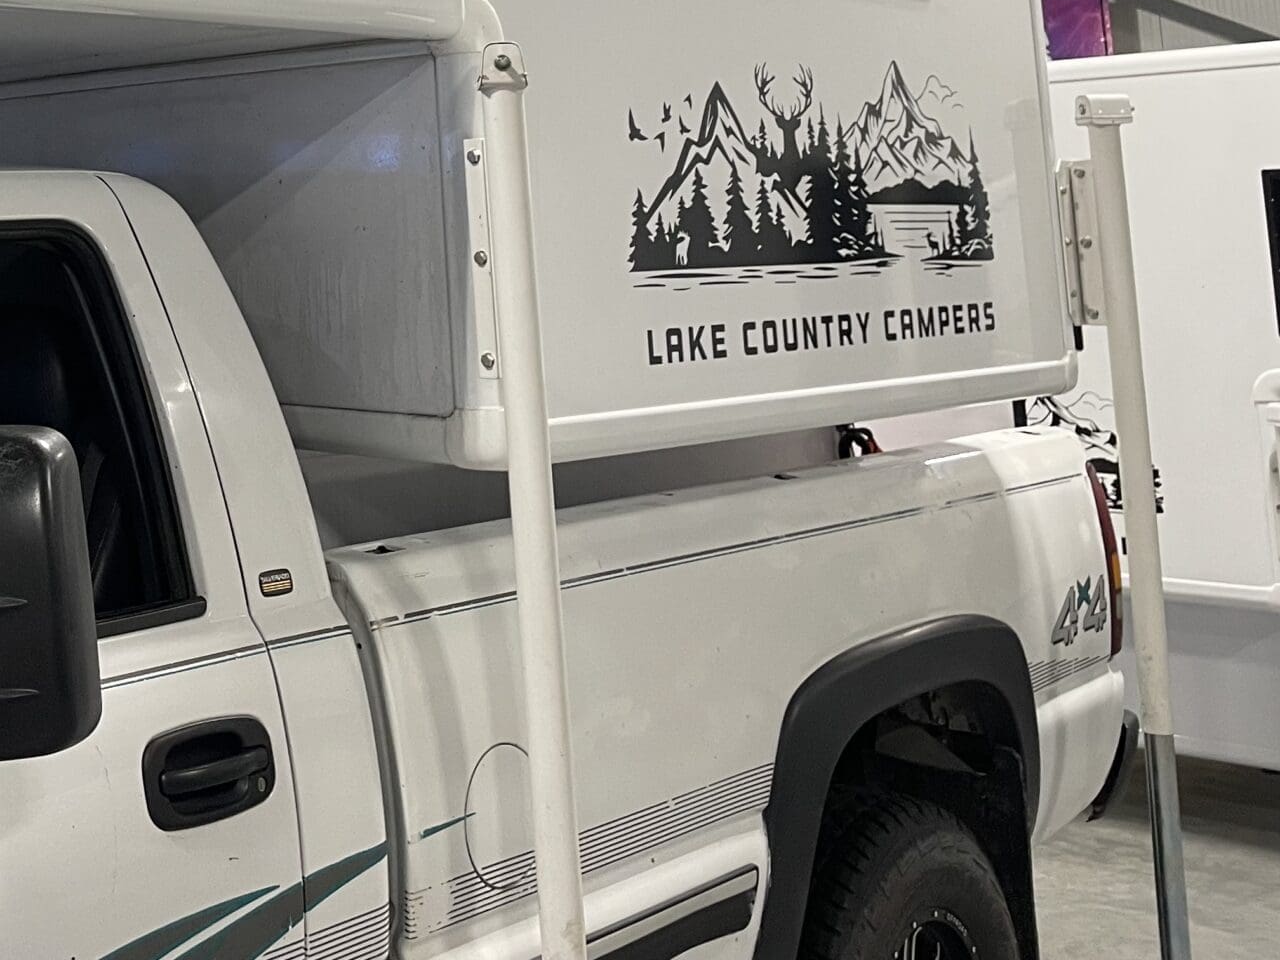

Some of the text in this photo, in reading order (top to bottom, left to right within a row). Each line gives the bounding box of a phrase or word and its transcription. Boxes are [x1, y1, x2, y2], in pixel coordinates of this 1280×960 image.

[647, 302, 996, 366] LAKE COUNTRY CAMPERS
